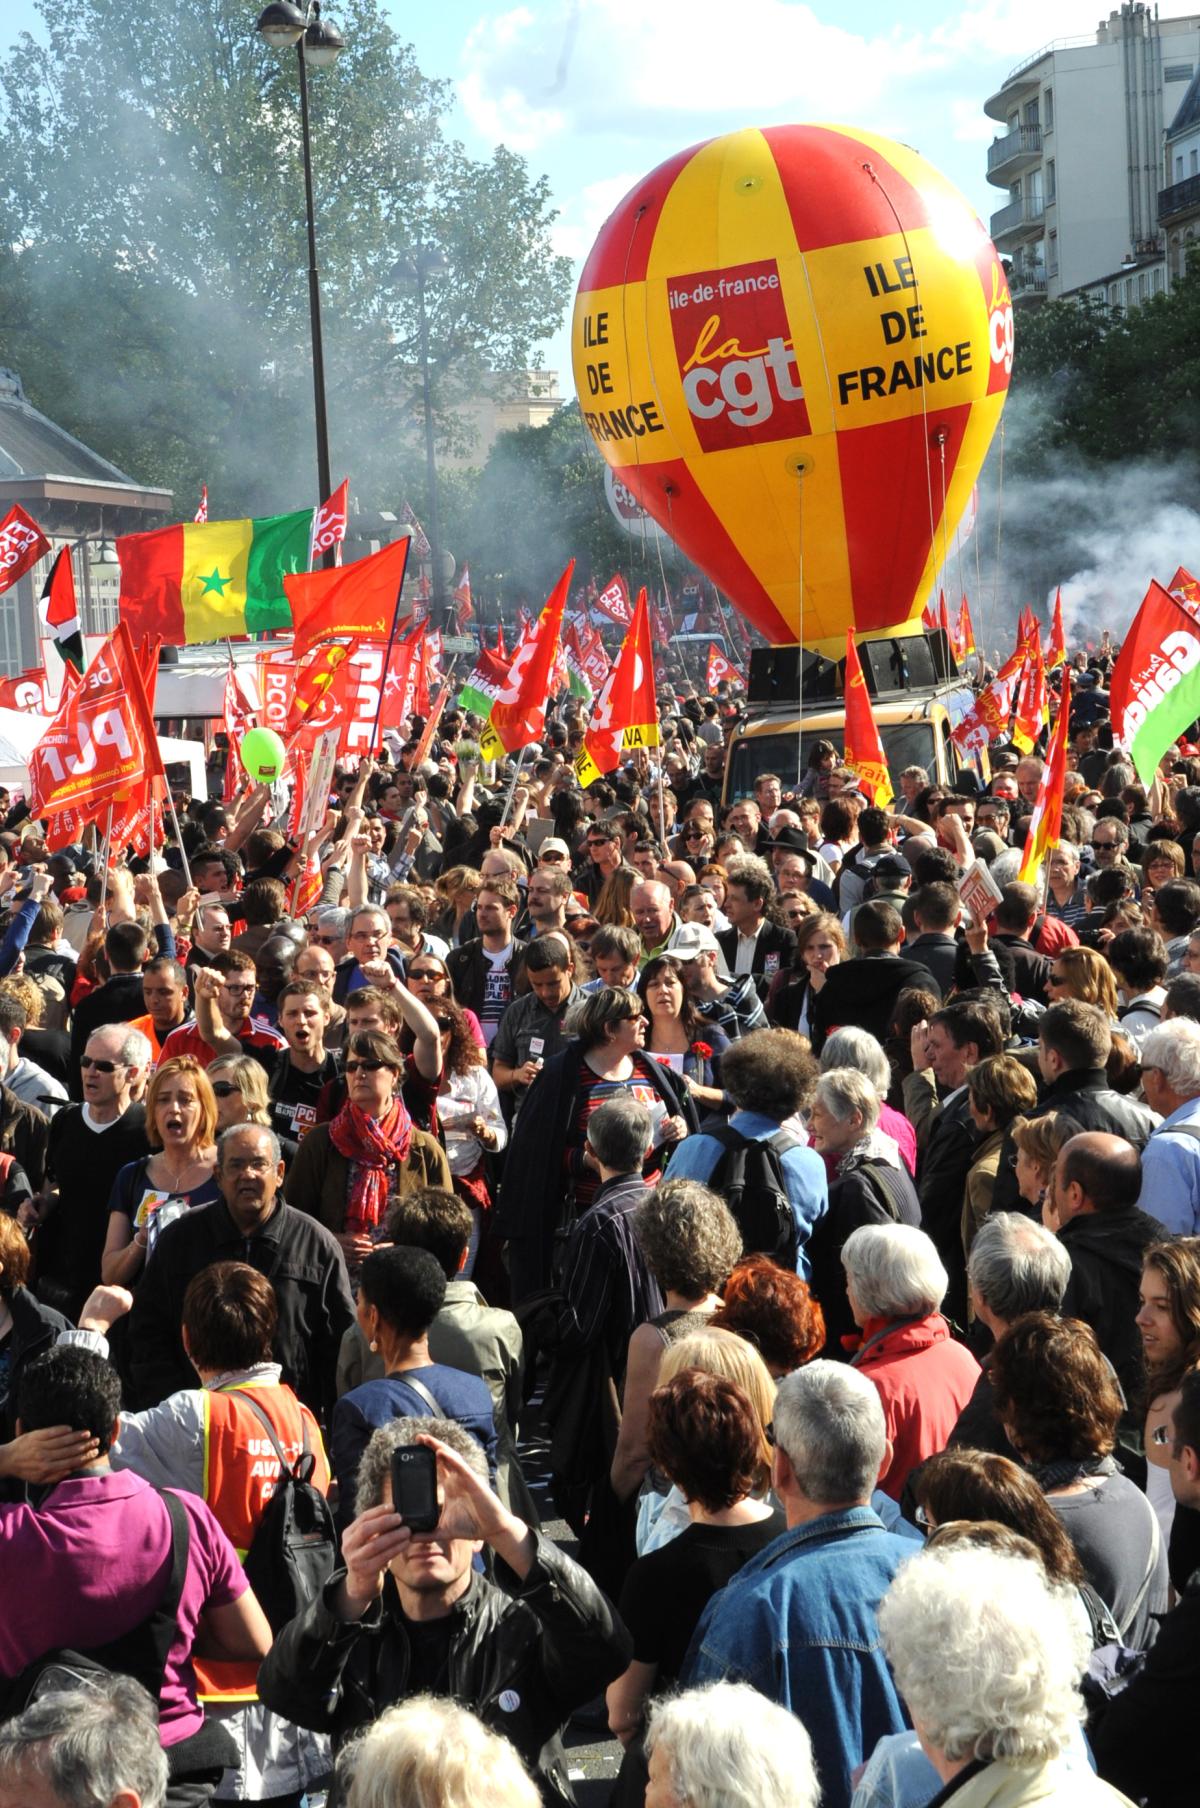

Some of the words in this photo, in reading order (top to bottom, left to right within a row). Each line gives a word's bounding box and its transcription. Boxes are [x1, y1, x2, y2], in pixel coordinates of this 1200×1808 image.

[668, 273, 779, 310] ile-de-france
[863, 256, 920, 298] ILE
[583, 312, 610, 349] ILE
[683, 314, 794, 371] la
[880, 304, 928, 346] DE
[990, 306, 1015, 375] cg
[587, 362, 614, 396] DE
[682, 337, 805, 428] cgt
[838, 341, 973, 405] FRANCE
